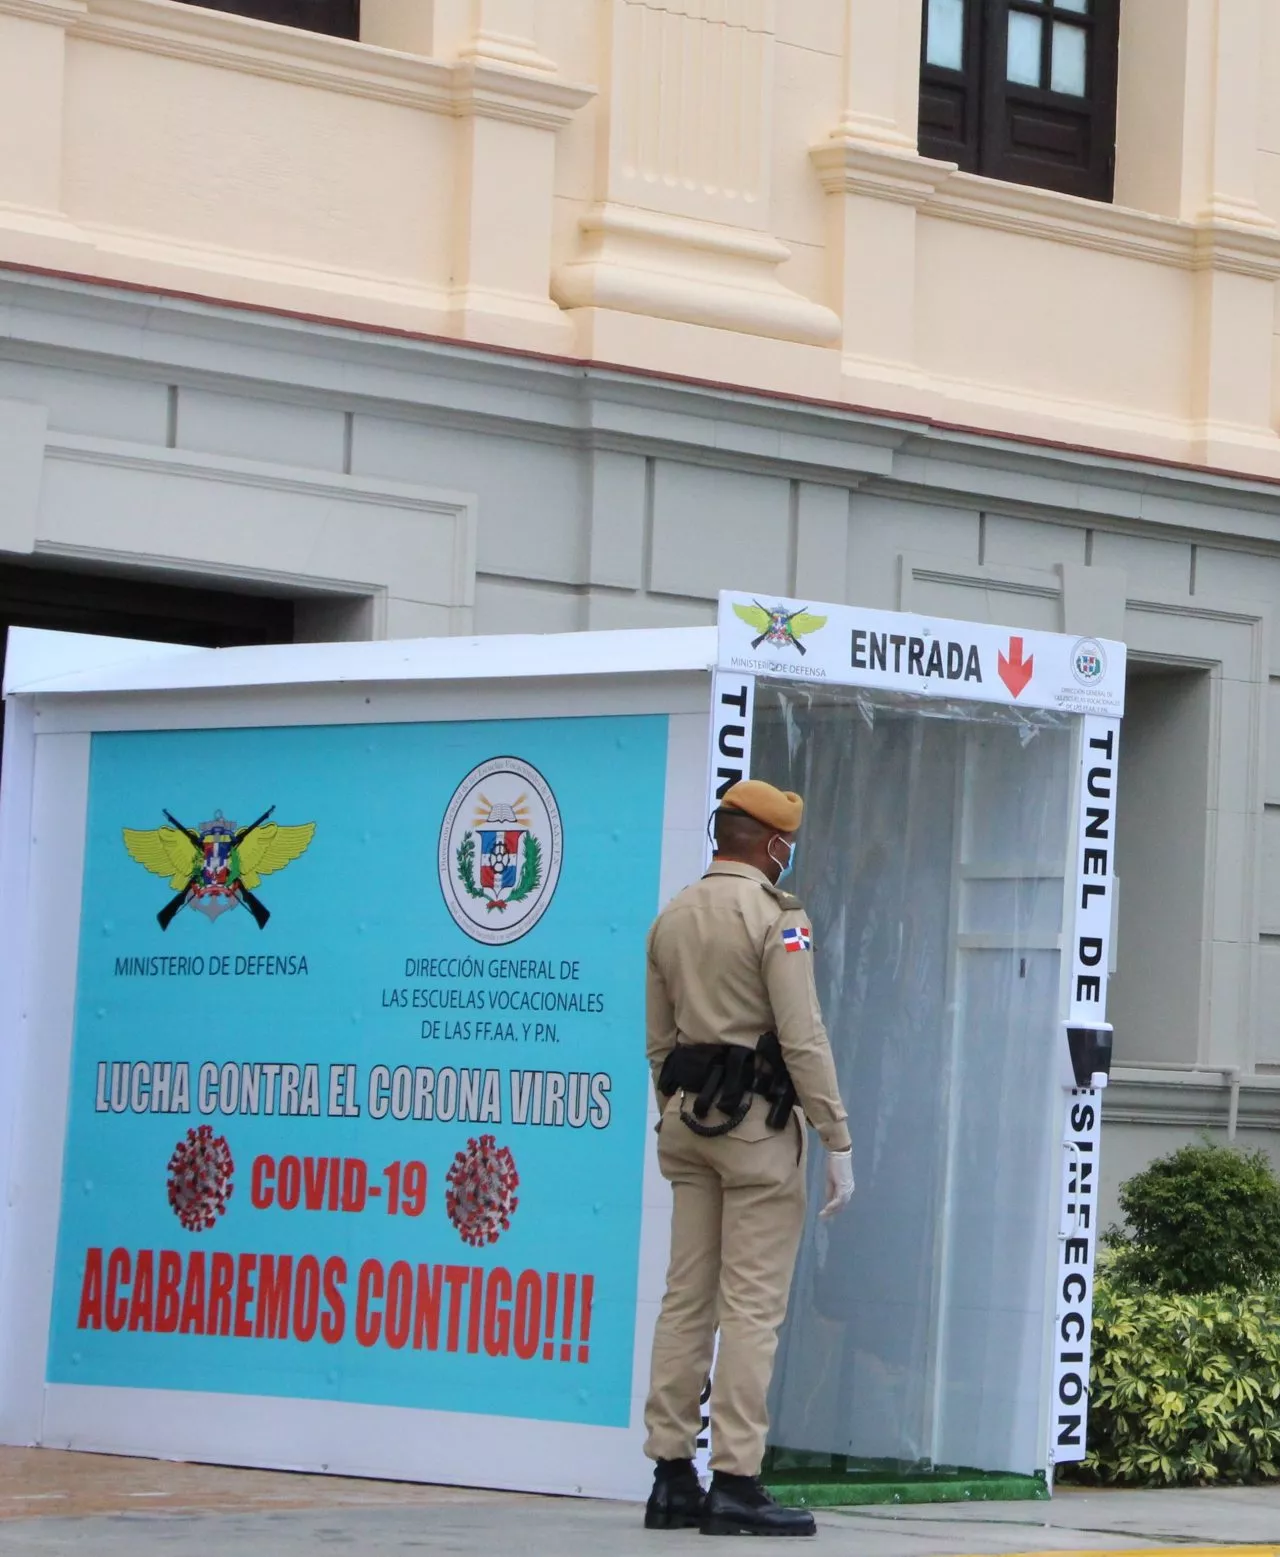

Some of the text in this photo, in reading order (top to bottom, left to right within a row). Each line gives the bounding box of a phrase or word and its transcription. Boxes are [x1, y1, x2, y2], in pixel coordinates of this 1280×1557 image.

[731, 657, 827, 678] MINISTERIO DE DEFENSA
[851, 629, 982, 683] ENTRADA
[714, 685, 748, 840] TUN
[115, 955, 309, 976] MINISTERIO DE DEFENSA
[405, 955, 580, 980] DIRECCIÓN GENERAL DE
[382, 988, 604, 1013] LAS ESCUELAS VOCACIONALES
[421, 1020, 560, 1043] DE LAS FF.AA. Y P.N.
[95, 1061, 612, 1129] LUCHA CONTRA EL CORONA VIRUS
[1057, 730, 1113, 1446] TUNEL DE SINFECCIÓN
[251, 1154, 427, 1217] COVID-19
[77, 1247, 595, 1364] ACABAREMOS CONTIGO!!!
